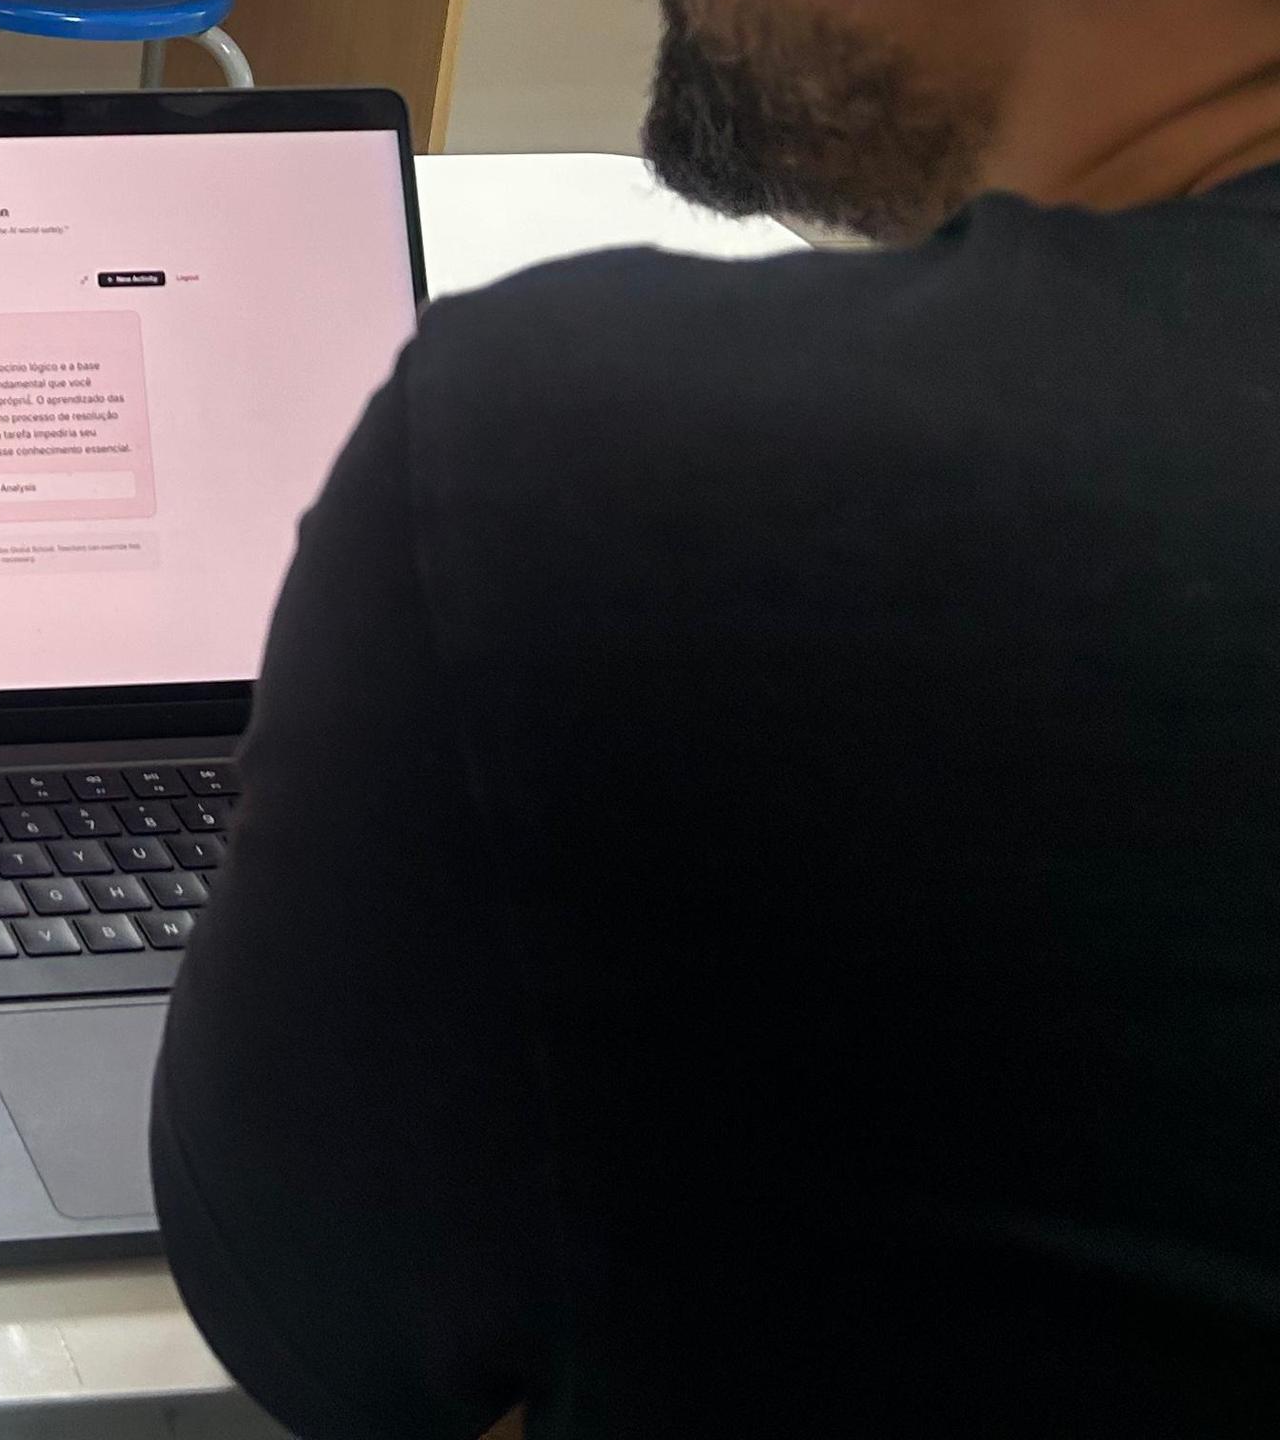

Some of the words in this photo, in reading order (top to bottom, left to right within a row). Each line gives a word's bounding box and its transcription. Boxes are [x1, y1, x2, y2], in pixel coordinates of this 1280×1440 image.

[0, 482, 36, 494] Analysis
[132, 847, 146, 859] U
[109, 886, 125, 898] H
[39, 929, 51, 941] V
[163, 923, 179, 935] N
